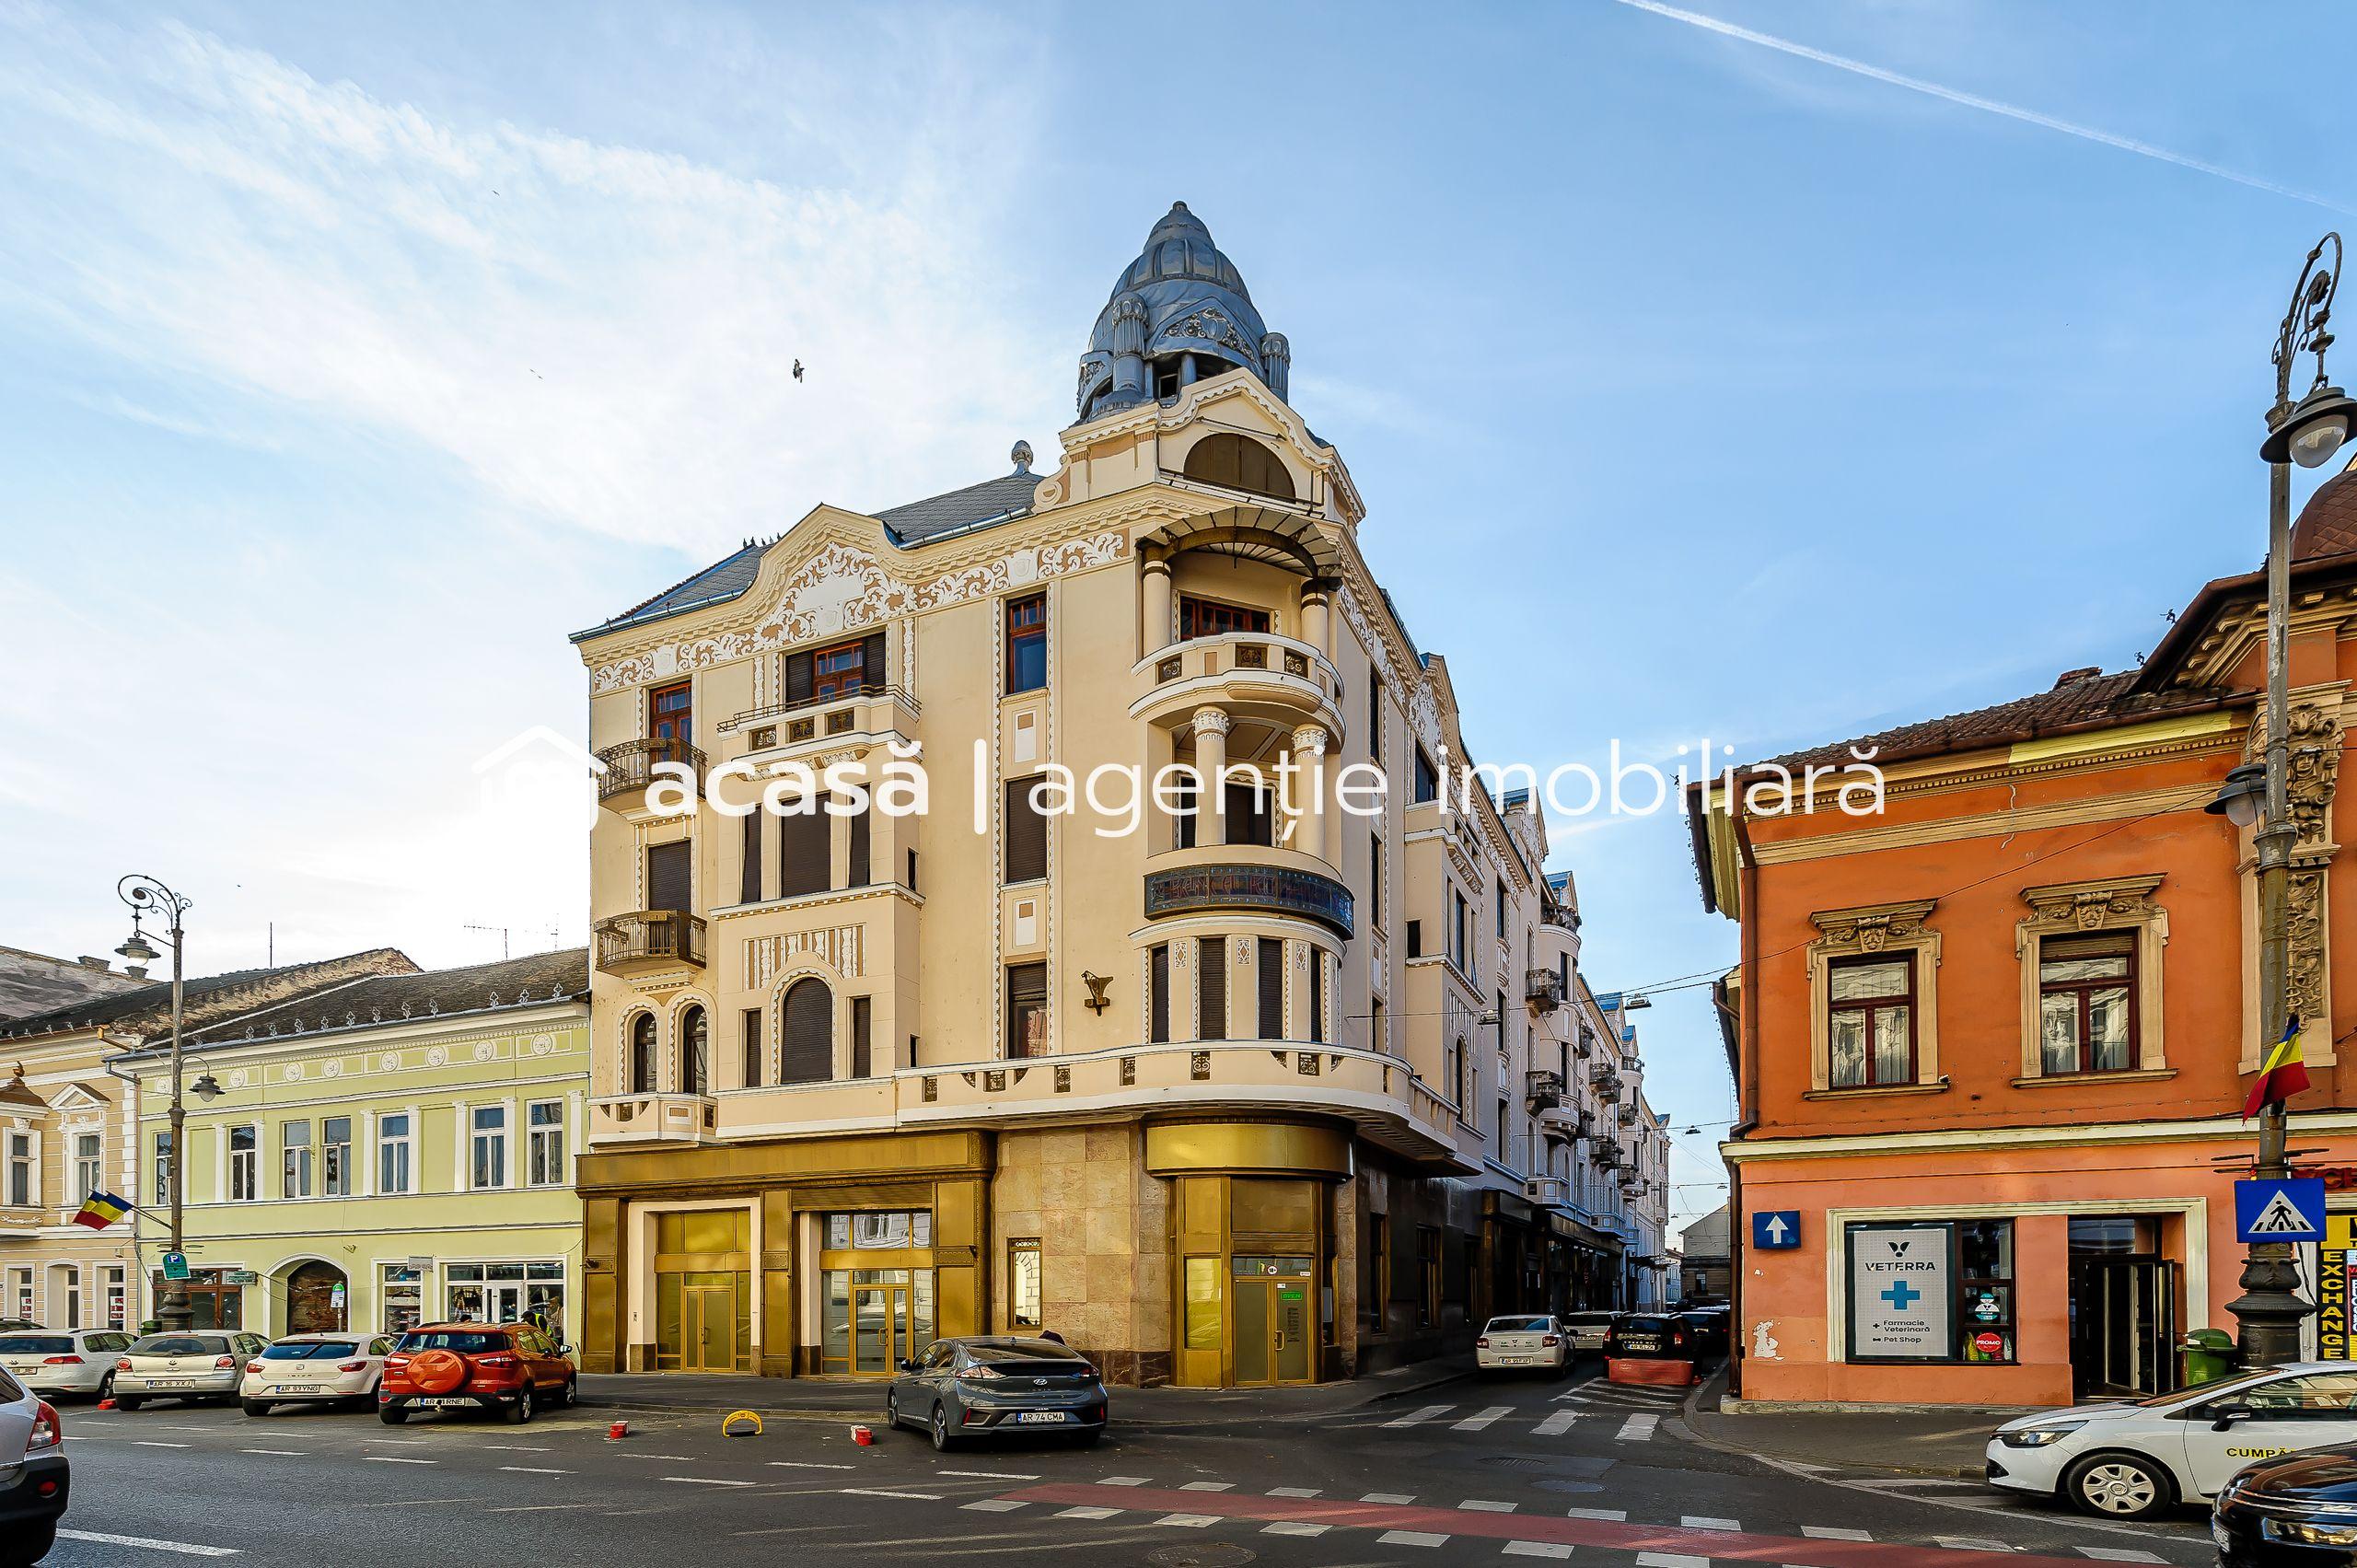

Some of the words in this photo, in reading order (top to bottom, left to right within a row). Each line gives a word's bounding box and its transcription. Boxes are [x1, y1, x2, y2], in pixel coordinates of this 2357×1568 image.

[1865, 1261, 1936, 1272] VETERRA
[2321, 1250, 2344, 1359] EXCHANGE
[1047, 1412, 1063, 1421] CMA
[2226, 1447, 2298, 1458] CUMPĂ
